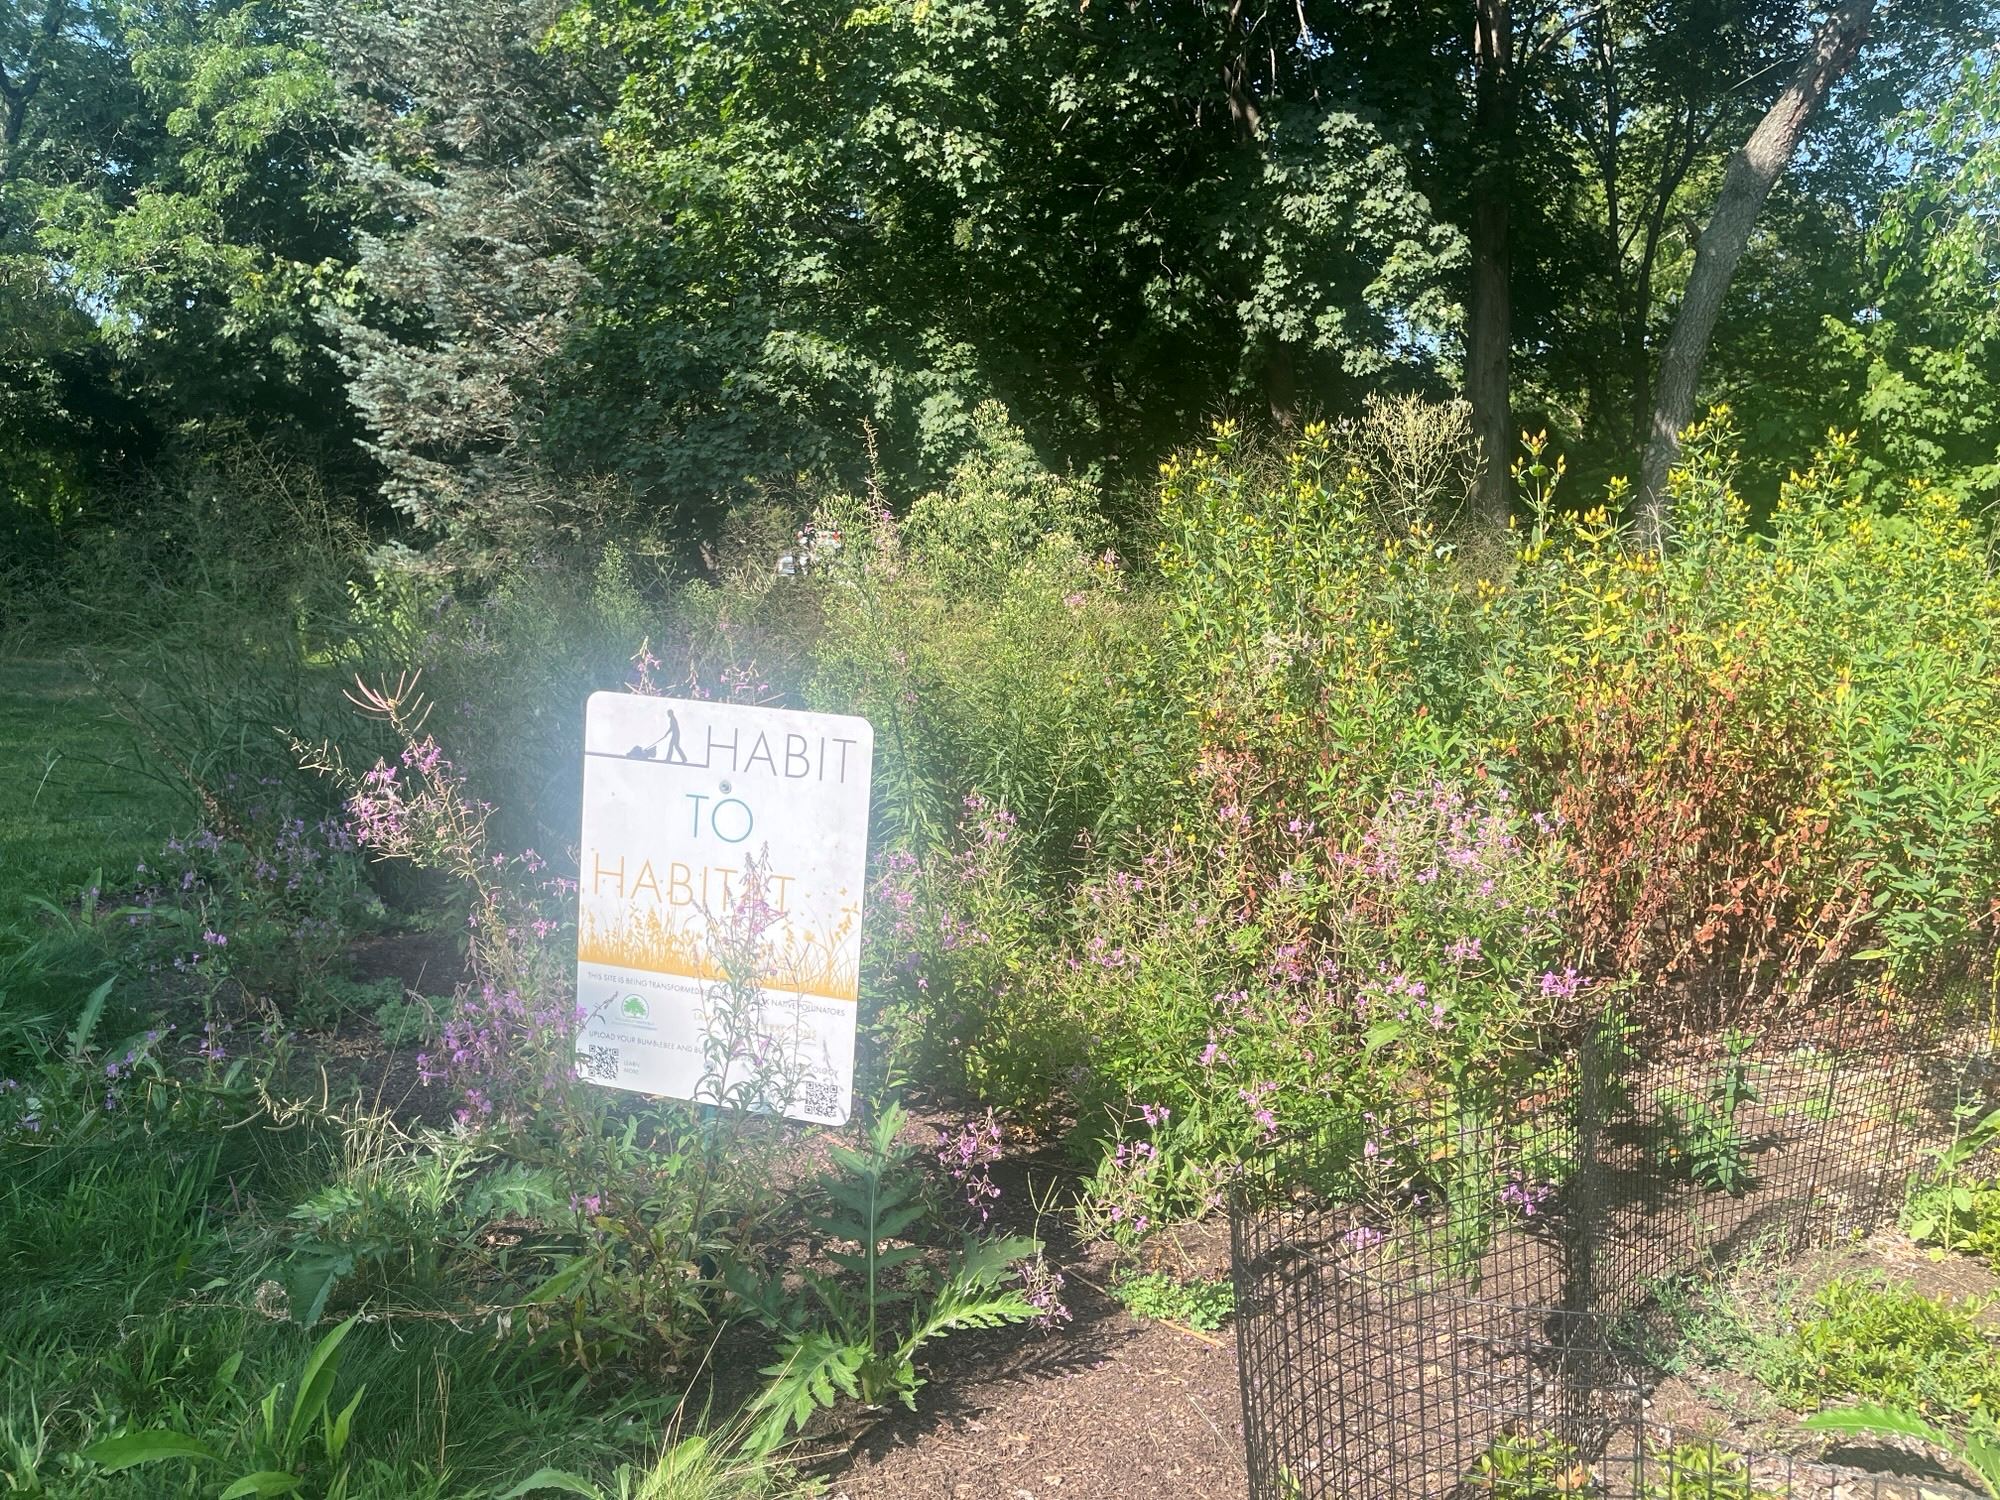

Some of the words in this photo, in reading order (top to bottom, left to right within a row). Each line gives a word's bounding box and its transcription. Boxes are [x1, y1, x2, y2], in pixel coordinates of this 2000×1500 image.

[706, 725, 857, 783] HABIT
[686, 793, 753, 843] TO
[588, 971, 602, 980] THIS
[603, 974, 617, 983] SITE
[618, 976, 625, 985] IS
[626, 977, 648, 988] BEING
[649, 981, 699, 995] TRANSFORMED
[589, 1030, 616, 1040] UPLOAD
[617, 1033, 635, 1043] YOUR
[637, 1036, 674, 1050] BUMBLEBEE
[676, 1043, 693, 1053] AND
